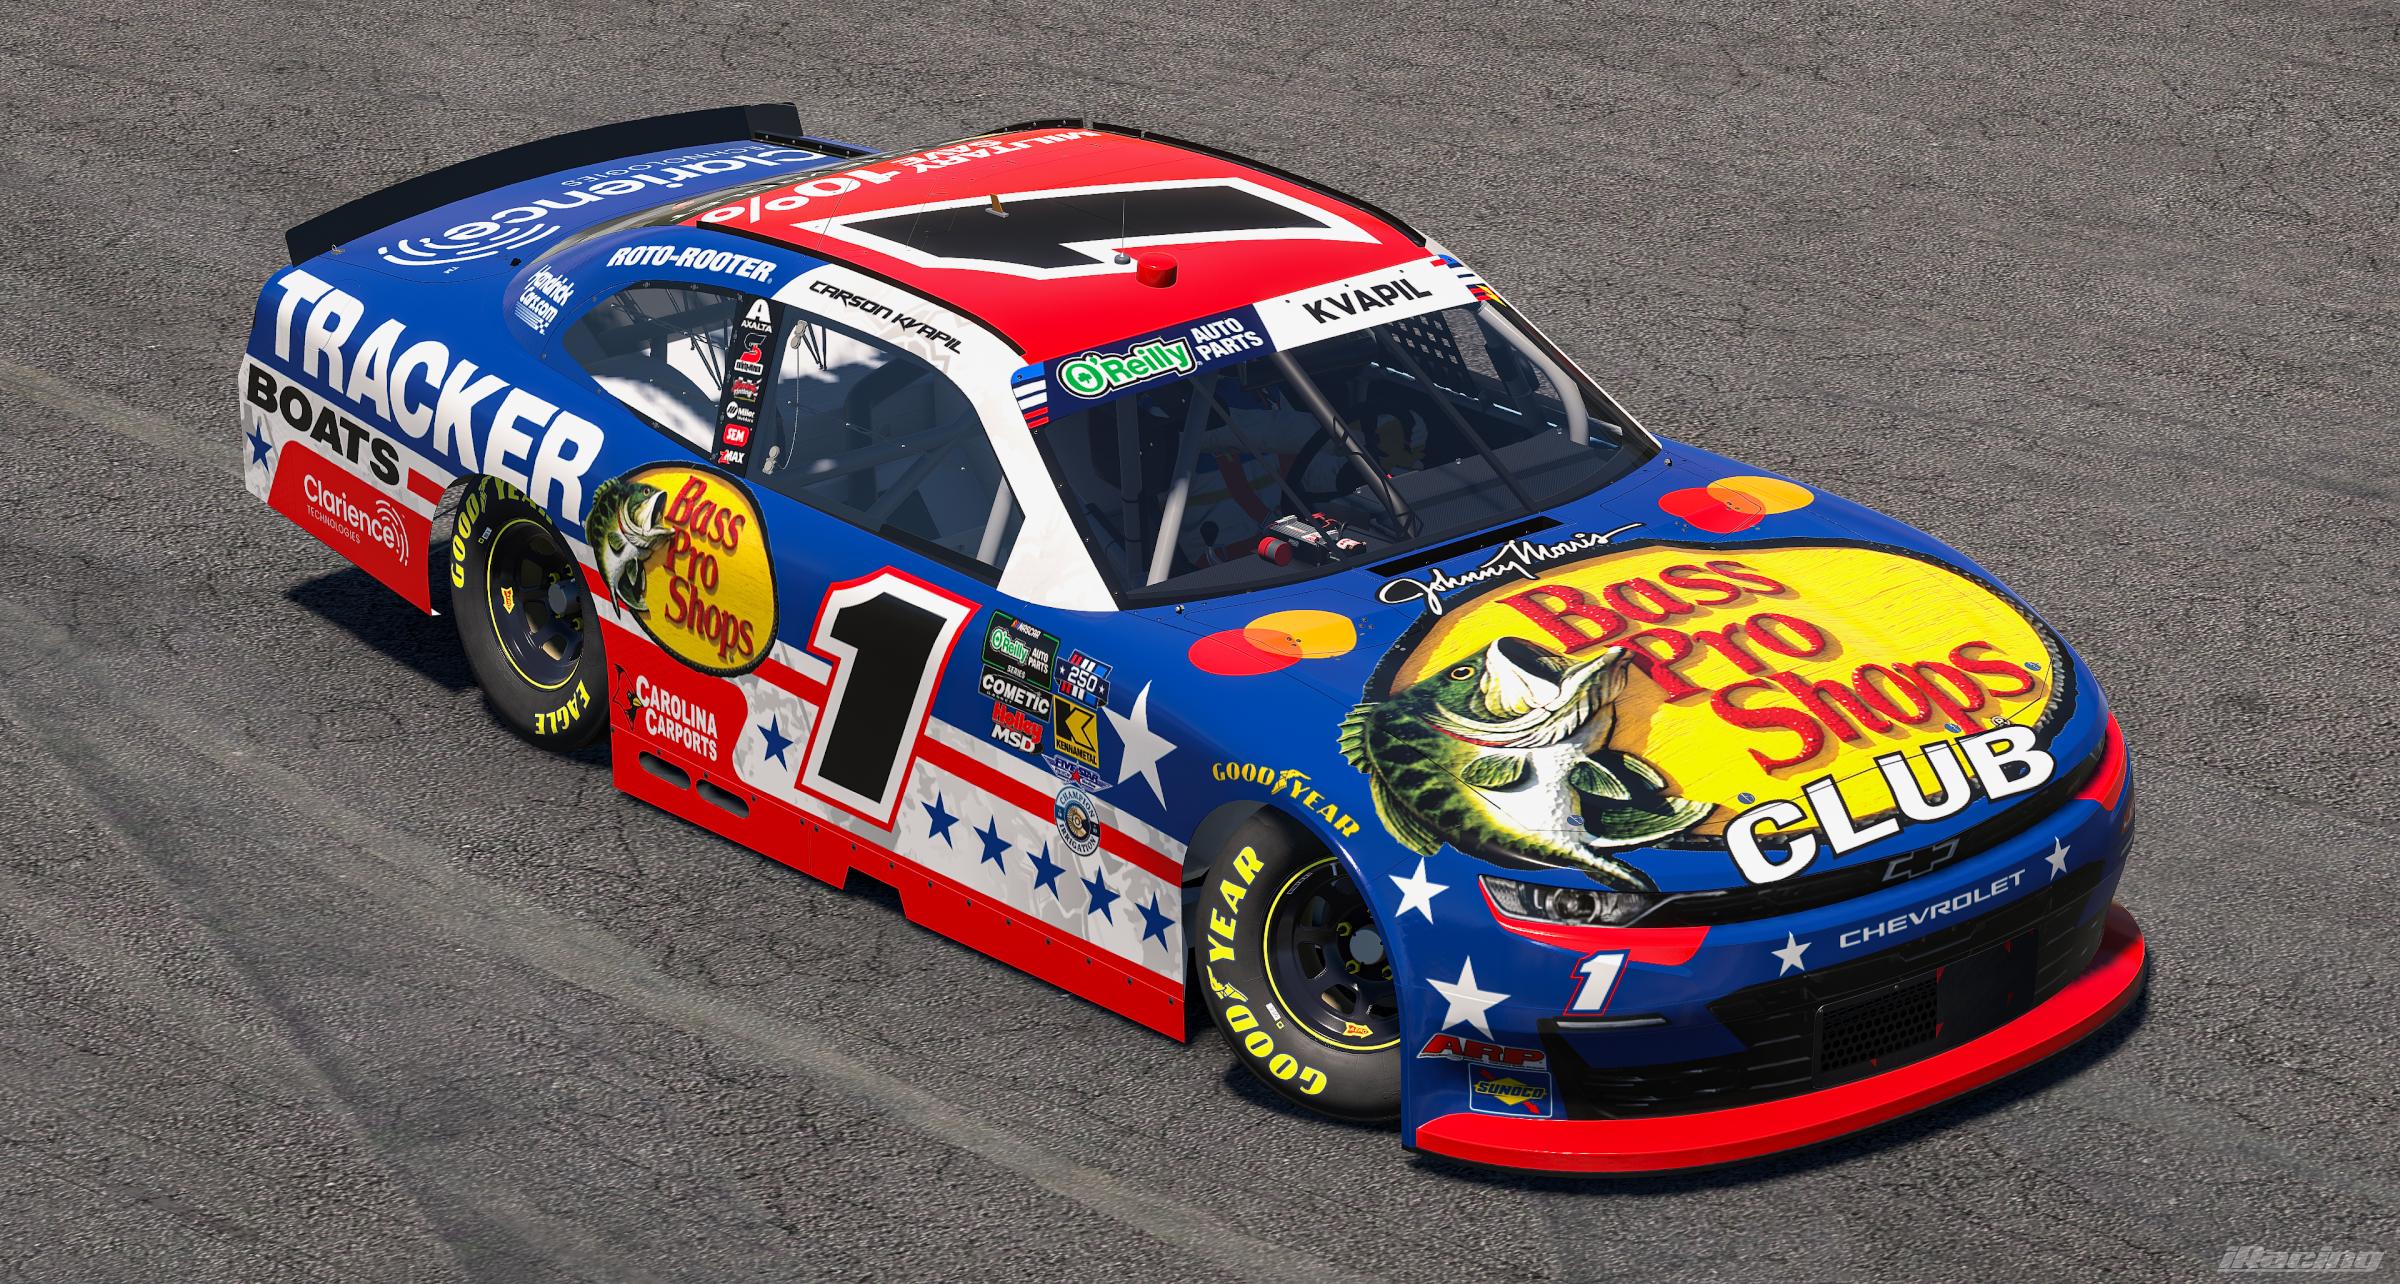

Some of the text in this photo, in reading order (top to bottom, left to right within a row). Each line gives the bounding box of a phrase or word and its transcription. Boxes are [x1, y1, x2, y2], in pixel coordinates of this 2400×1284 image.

[914, 131, 1101, 174] MILITARY
[444, 150, 826, 240] Clarience
[700, 169, 900, 222] 10%
[524, 264, 574, 306] Hendrick
[607, 244, 773, 283] ROTO-ROOTER
[520, 286, 558, 323] Cars.com
[809, 280, 962, 354] CARSON KVAPIL
[1302, 278, 1433, 324] KVAPIL
[741, 320, 772, 333] AXALTA
[1190, 317, 1244, 344] AUTO
[1195, 331, 1264, 362] PARTS
[1064, 341, 1191, 394] O'Reilly
[276, 268, 605, 526] TRACKER
[247, 365, 400, 486] BOATS
[726, 427, 745, 443] SEM
[304, 474, 395, 549] Clarience
[307, 504, 360, 544] TECHNOLOGIES
[664, 475, 746, 550] Bass
[663, 526, 719, 590] Pro
[1481, 523, 1643, 568] Morris
[1379, 560, 1540, 616] Johnny
[1497, 560, 1787, 655] Bass
[664, 575, 754, 658] Shops
[991, 628, 1029, 664] O'Reilly
[1027, 657, 1048, 674] PARTS
[1031, 647, 1048, 662] AUTO
[1624, 611, 1827, 704] Pro
[982, 673, 1050, 714] COMETIC
[1006, 665, 1026, 679] SERIES
[1067, 665, 1098, 692] 250
[534, 680, 592, 736] EAGLE
[636, 675, 718, 739] CAROLINA
[804, 577, 966, 820] 1
[1710, 639, 2036, 777] Shops
[645, 708, 717, 761] CARPORTS
[991, 700, 1043, 744] Holley
[991, 724, 1036, 753] MSD
[1055, 738, 1098, 766] KENNAMETAL
[1060, 791, 1096, 819] CHAMPION
[1724, 725, 2055, 886] CLUB
[1059, 823, 1097, 853] IRRIGATION
[1838, 867, 2026, 950] CHEVROLET
[1568, 951, 1628, 1013] 1
[1420, 1033, 1546, 1066] ARP
[1476, 1081, 1546, 1099] SUNOCO
